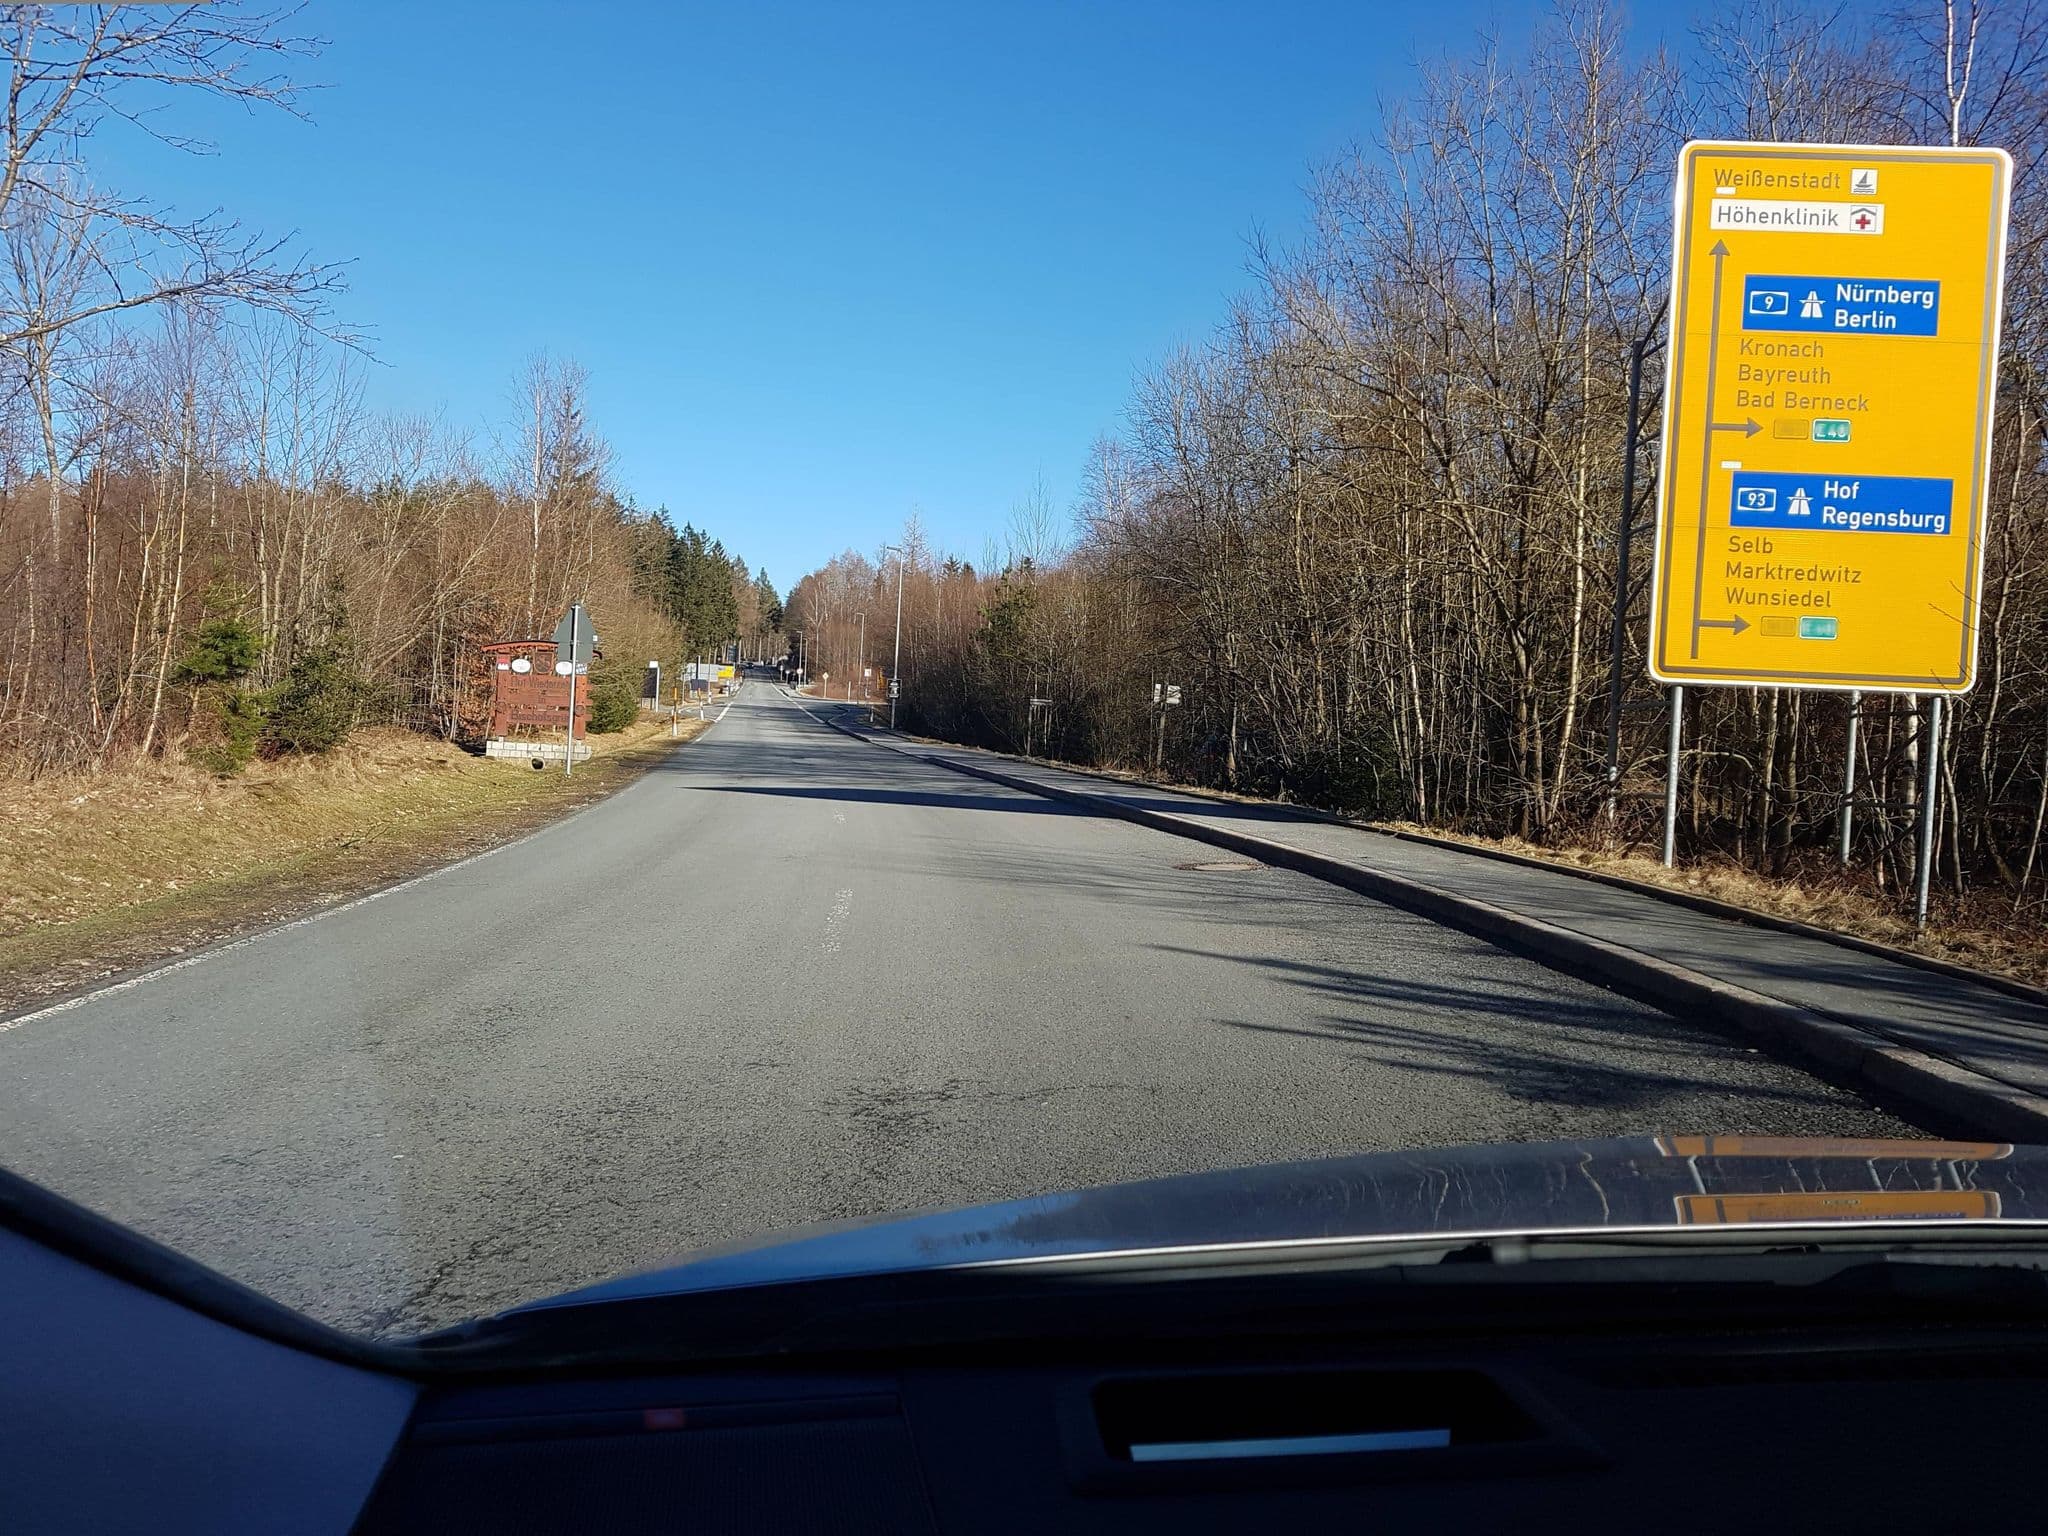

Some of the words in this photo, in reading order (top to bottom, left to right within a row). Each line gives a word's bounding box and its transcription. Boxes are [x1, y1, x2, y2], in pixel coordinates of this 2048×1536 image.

[1714, 168, 1841, 190] Weißenstadt
[1718, 206, 1838, 227] Höhenklinik
[1764, 296, 1774, 311] 9
[1836, 284, 1934, 308] Nürnberg
[1835, 309, 1896, 329] Berlin
[1739, 338, 1825, 359] Kronach
[1738, 364, 1831, 386] Bayreuth
[1736, 390, 1776, 409] Bad
[1784, 392, 1869, 411] Berneck
[1748, 492, 1766, 507] 93
[1824, 480, 1860, 500] Hof
[1822, 506, 1946, 532] Regensburg
[1728, 536, 1774, 555] Selb
[1725, 561, 1862, 584] Marktredwitz
[1726, 587, 1832, 609] Wunsiedel
